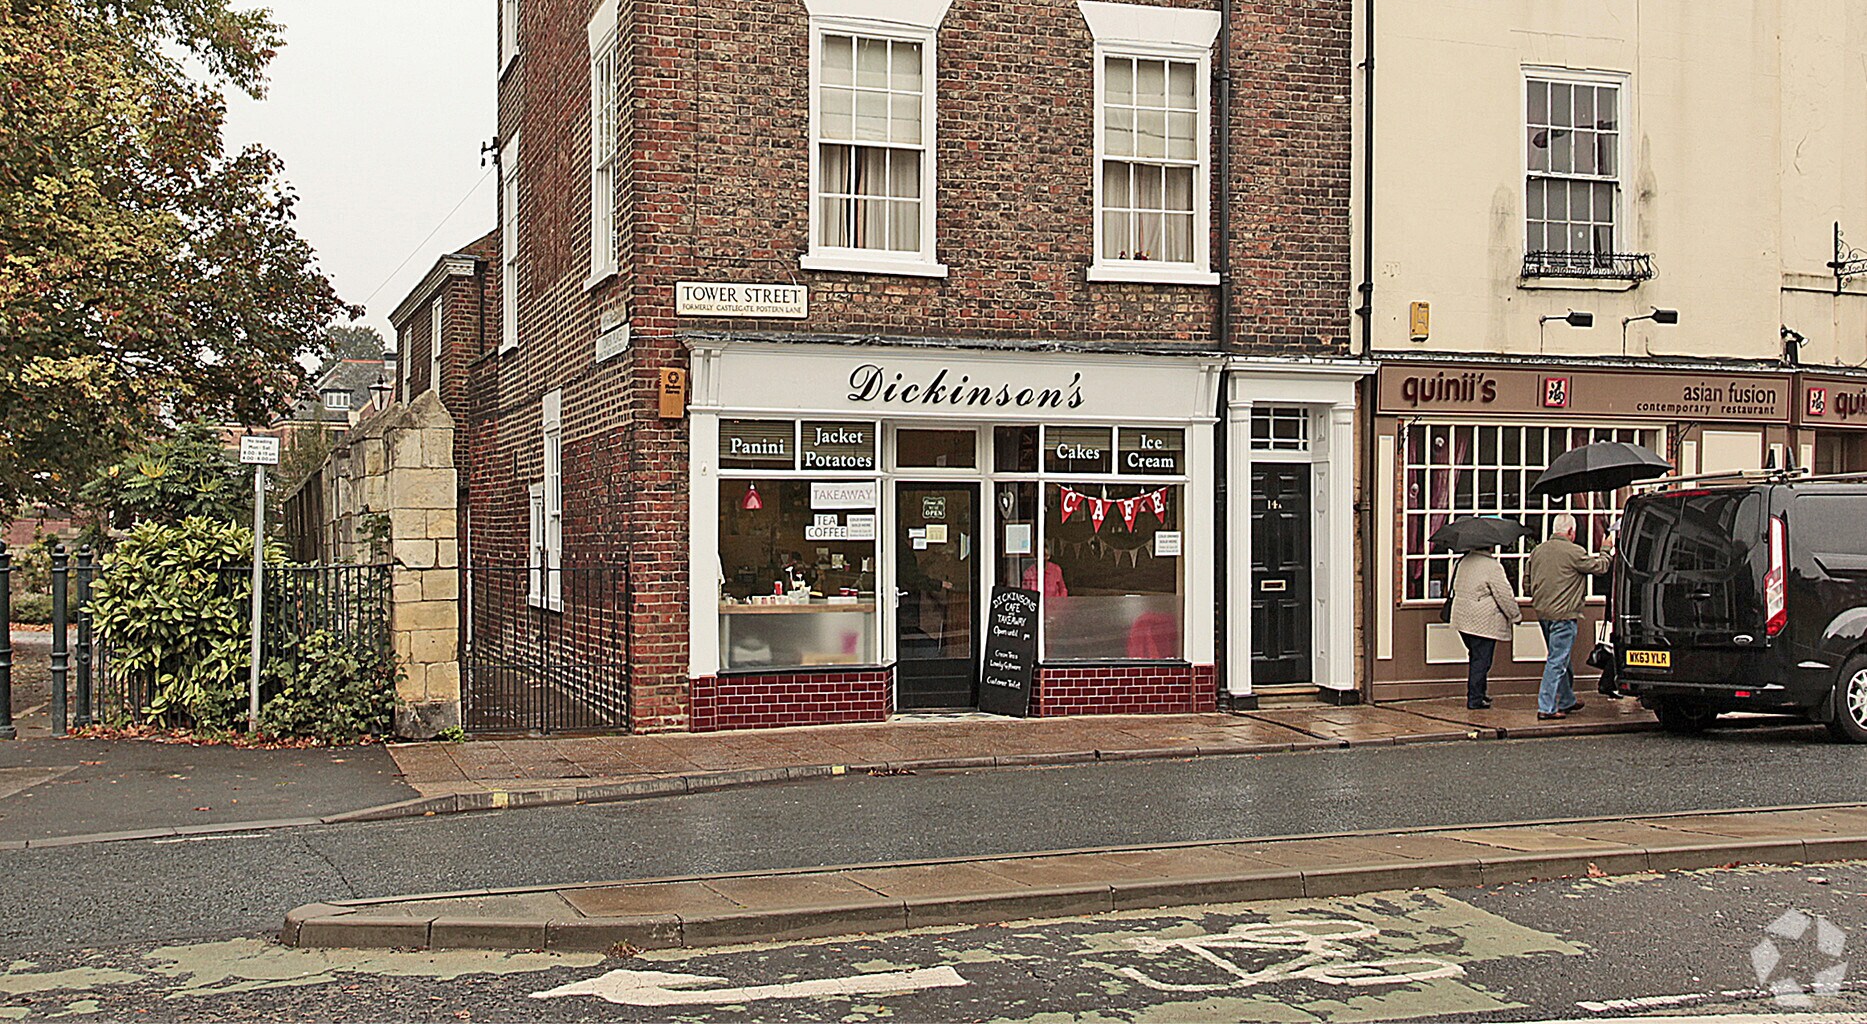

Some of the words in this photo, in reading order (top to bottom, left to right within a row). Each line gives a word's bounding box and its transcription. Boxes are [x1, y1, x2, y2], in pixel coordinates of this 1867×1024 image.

[683, 286, 738, 303] TOWER
[745, 288, 801, 304] STREET
[756, 305, 784, 313] POSTERN
[848, 364, 1085, 408] Dickinson's
[1402, 372, 1497, 407] quinii's
[1683, 383, 1722, 402] asian
[1728, 382, 1776, 403] fusion
[1637, 402, 1711, 415] contemporary
[1721, 405, 1775, 415] restaurant
[814, 428, 863, 446] Jacket
[1141, 434, 1163, 449] Ice
[730, 438, 785, 454] Panini
[1056, 443, 1100, 459] Cakes
[805, 451, 872, 468] Potatoes
[1127, 452, 1175, 468] Cream
[813, 489, 872, 500] TAKEAWAY
[817, 516, 836, 525] TEA
[808, 527, 846, 537] COFFEE
[992, 592, 1037, 612] DICKINSONS
[1004, 602, 1021, 613] CAFE
[1629, 652, 1650, 663] WK63
[1651, 653, 1667, 664] YLR
